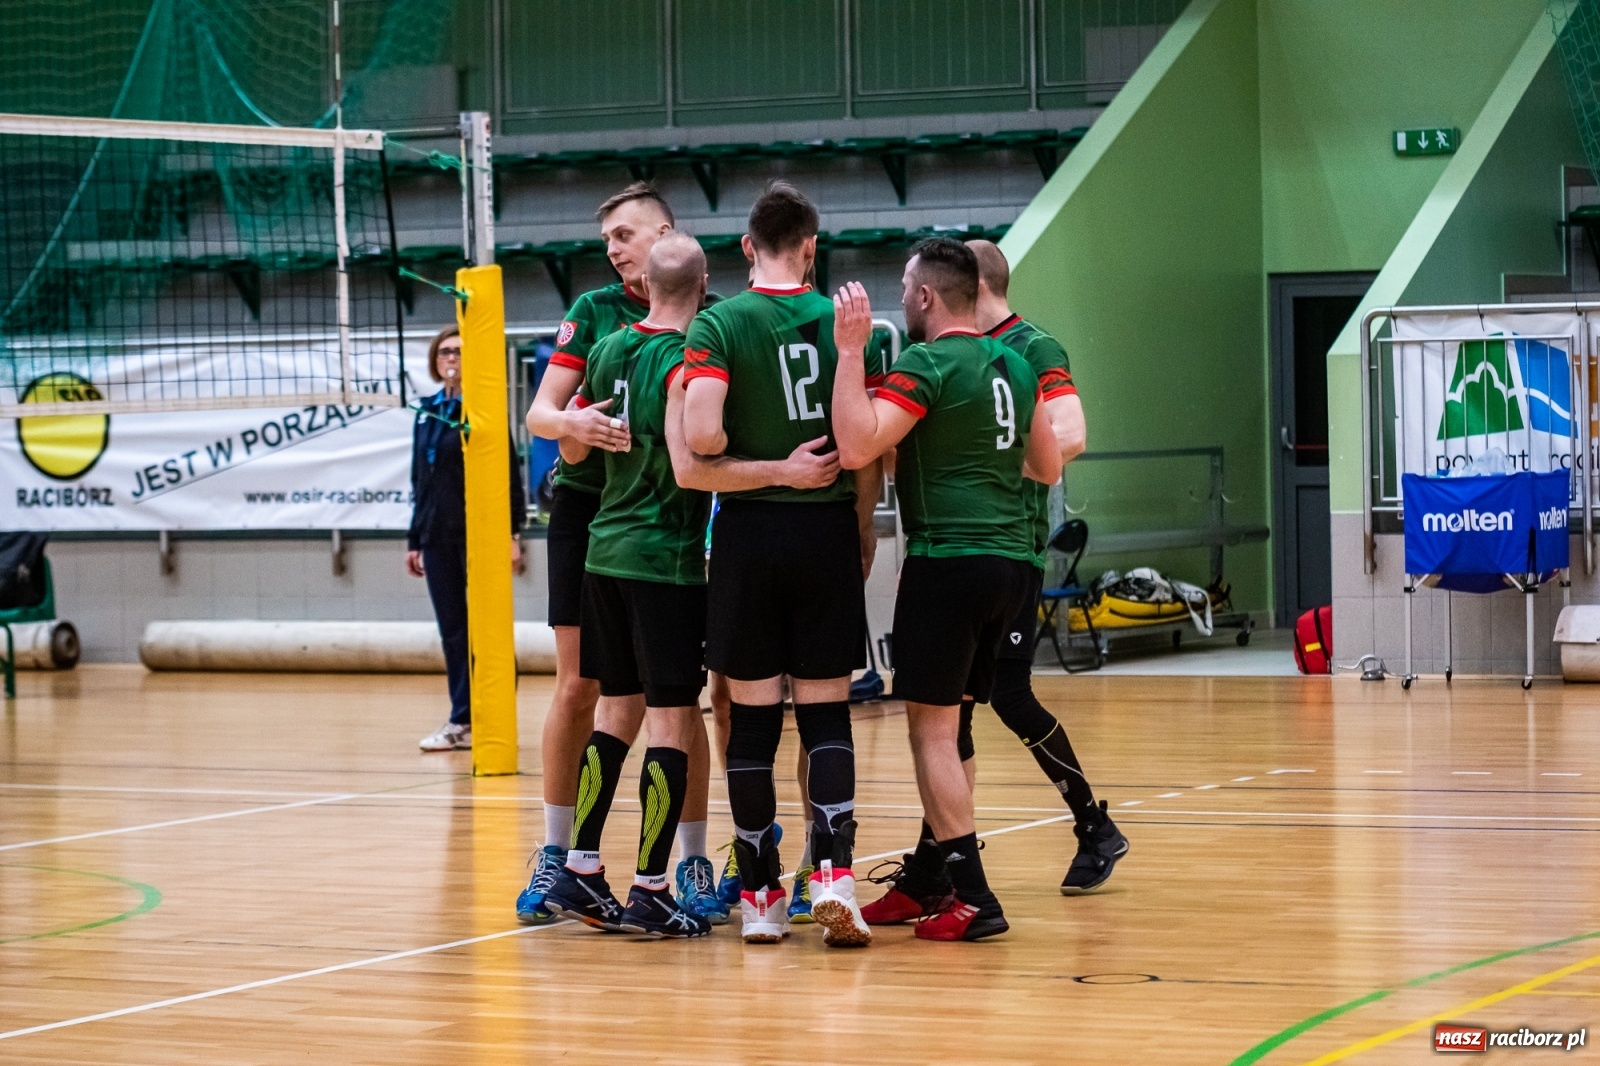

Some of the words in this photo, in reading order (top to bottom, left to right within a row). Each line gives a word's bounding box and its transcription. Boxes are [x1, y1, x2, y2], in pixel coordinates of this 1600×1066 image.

[779, 343, 825, 421] 12
[992, 377, 1016, 450] 9
[16, 483, 115, 508] RACIBÓRZ
[131, 450, 198, 499] JEST
[206, 437, 233, 468] W
[1422, 508, 1514, 533] molten
